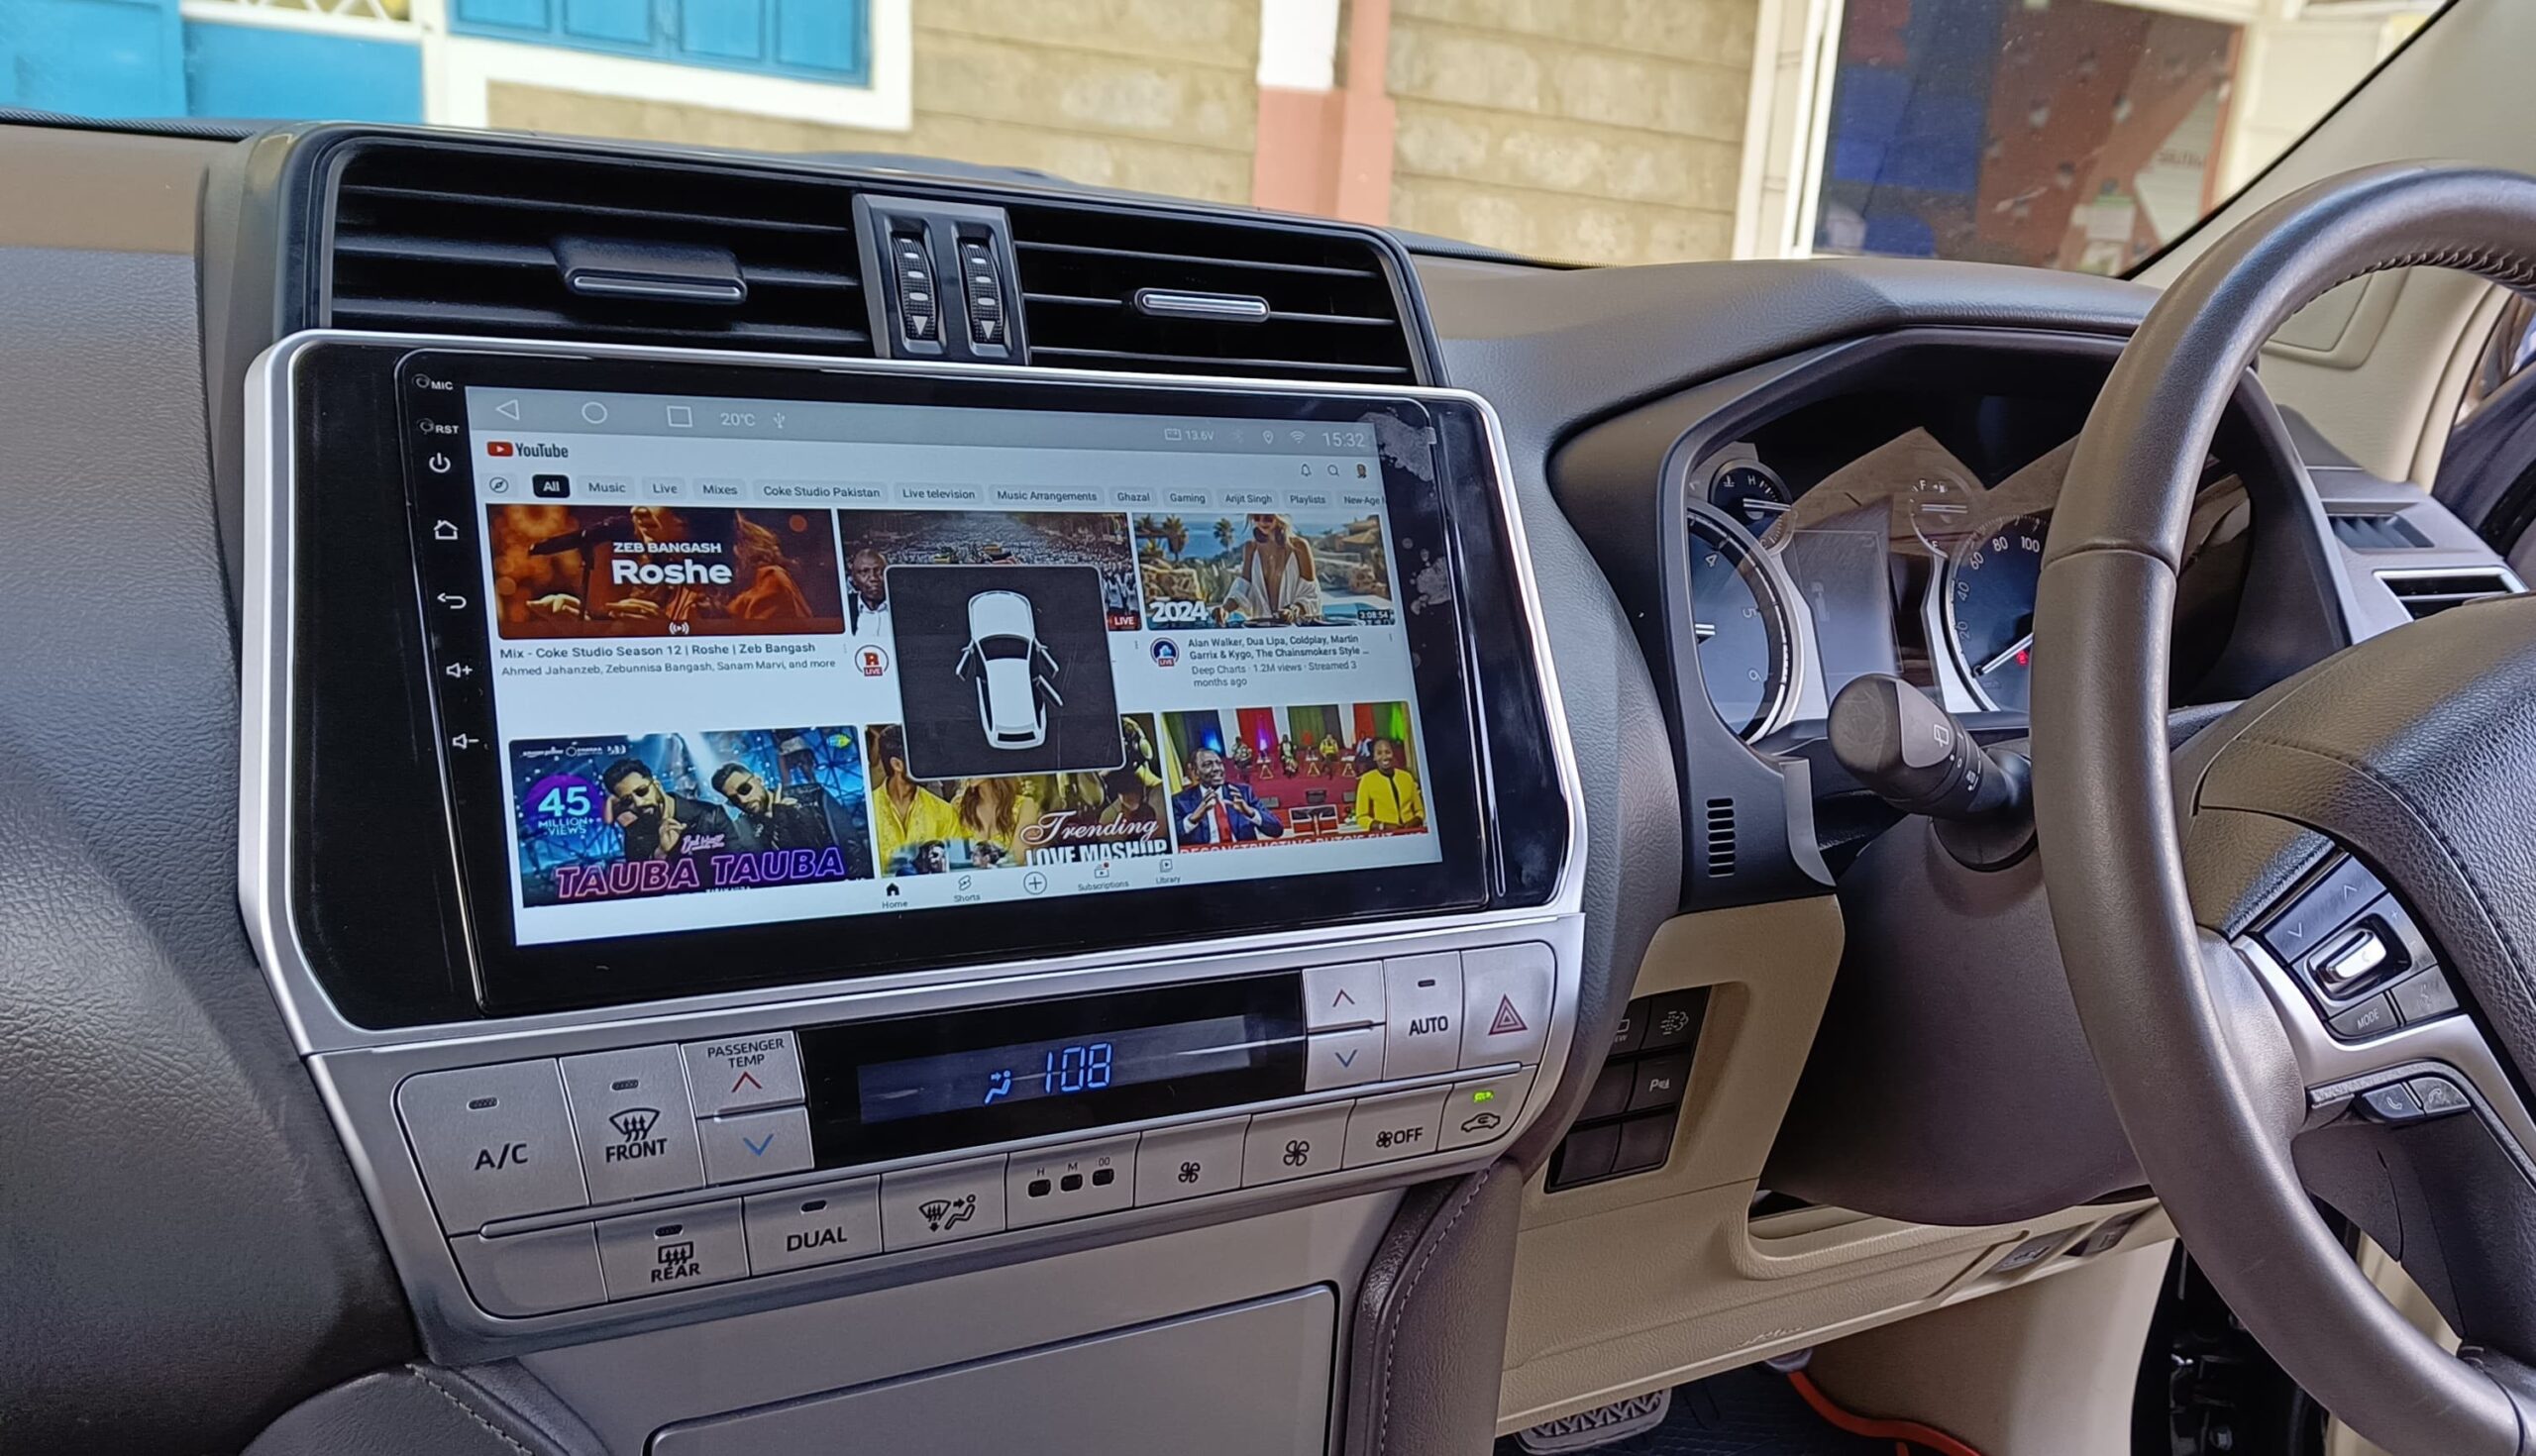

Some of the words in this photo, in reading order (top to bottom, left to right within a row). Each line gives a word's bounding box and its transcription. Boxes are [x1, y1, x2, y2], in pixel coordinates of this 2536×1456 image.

[431, 380, 454, 390] MIC
[435, 424, 460, 435] RST
[1185, 430, 1215, 441] 13.6V
[1321, 432, 1365, 447] 15:32
[515, 442, 569, 458] YouTube
[543, 481, 560, 492] All
[1746, 474, 1756, 485] H
[588, 482, 626, 493] Music
[652, 483, 678, 494] Live
[702, 484, 738, 495] Mixes
[763, 485, 792, 496] Coke
[793, 486, 831, 497] Studio
[832, 487, 881, 498] Pakistan
[902, 489, 925, 499] Live
[926, 489, 976, 499] television
[997, 490, 1027, 500] Music
[1029, 490, 1098, 503] Arrangements
[1116, 491, 1150, 502] Ghazal
[1170, 492, 1206, 504] Gaming
[1247, 494, 1272, 505] Singh
[1290, 494, 1326, 505] Playlists
[613, 542, 645, 554] ZEB
[647, 542, 722, 554] BANGASH
[1992, 536, 2009, 553] 80
[2020, 536, 2041, 553] 100
[1705, 554, 1718, 568] 4
[1969, 552, 1984, 571] 60
[611, 558, 733, 585] Roshe
[1956, 581, 1970, 602] 40
[1149, 600, 1209, 623] 2024
[1113, 616, 1135, 626] LIVE
[1188, 638, 1210, 648] Alan
[1211, 637, 1245, 648] Walker,
[1246, 636, 1265, 646] Dua
[1289, 635, 1329, 646] Coldplay,
[1330, 634, 1359, 644] Martin
[499, 648, 524, 659] Mix
[535, 647, 569, 659] Coke
[572, 646, 613, 658] Studio
[616, 646, 663, 657] Season
[667, 645, 683, 656] 12
[691, 644, 729, 655] Roshe
[738, 644, 763, 654] Zeb
[765, 643, 816, 655] Bangash
[1219, 650, 1227, 659] &
[1227, 649, 1254, 661] Kygo,
[1255, 649, 1273, 658] The
[1275, 647, 1337, 658] Chainsmokers
[1338, 646, 1361, 657] Style
[501, 667, 542, 676] Ahmed
[545, 665, 604, 676] Jahanzeb,
[605, 663, 663, 674] Zebunnisa
[664, 662, 715, 674] Bangash,
[717, 661, 754, 671] Sanam
[756, 660, 787, 671] Marvi,
[789, 660, 808, 670] and
[810, 660, 836, 669] more
[1192, 666, 1215, 676] Deep
[1216, 665, 1247, 675] Charts
[1277, 663, 1303, 673] views
[1308, 661, 1349, 672] Streamed
[1350, 660, 1357, 670] 3
[1193, 677, 1228, 687] months
[1229, 677, 1248, 688] ago
[538, 785, 591, 817] 45
[548, 825, 587, 836] VIEWS
[1019, 809, 1159, 846] Trending
[555, 857, 700, 899] TAUBA
[710, 847, 846, 885] TAUBA
[1077, 880, 1129, 892] Subscriptions
[1156, 876, 1181, 885] Library
[882, 900, 908, 909] Home
[953, 893, 981, 903] Shorts
[1408, 1014, 1449, 1037] AUTO
[2357, 1007, 2379, 1030] MODE
[707, 1038, 785, 1059] PASSENGER
[728, 1053, 765, 1069] TEMP
[1393, 1126, 1424, 1145] OFF
[474, 1143, 529, 1171] A/C
[605, 1138, 669, 1164] FRONT
[1036, 1168, 1045, 1177] H
[1067, 1162, 1079, 1172] M
[787, 1226, 848, 1252] DUAL
[650, 1262, 701, 1284] REAR
